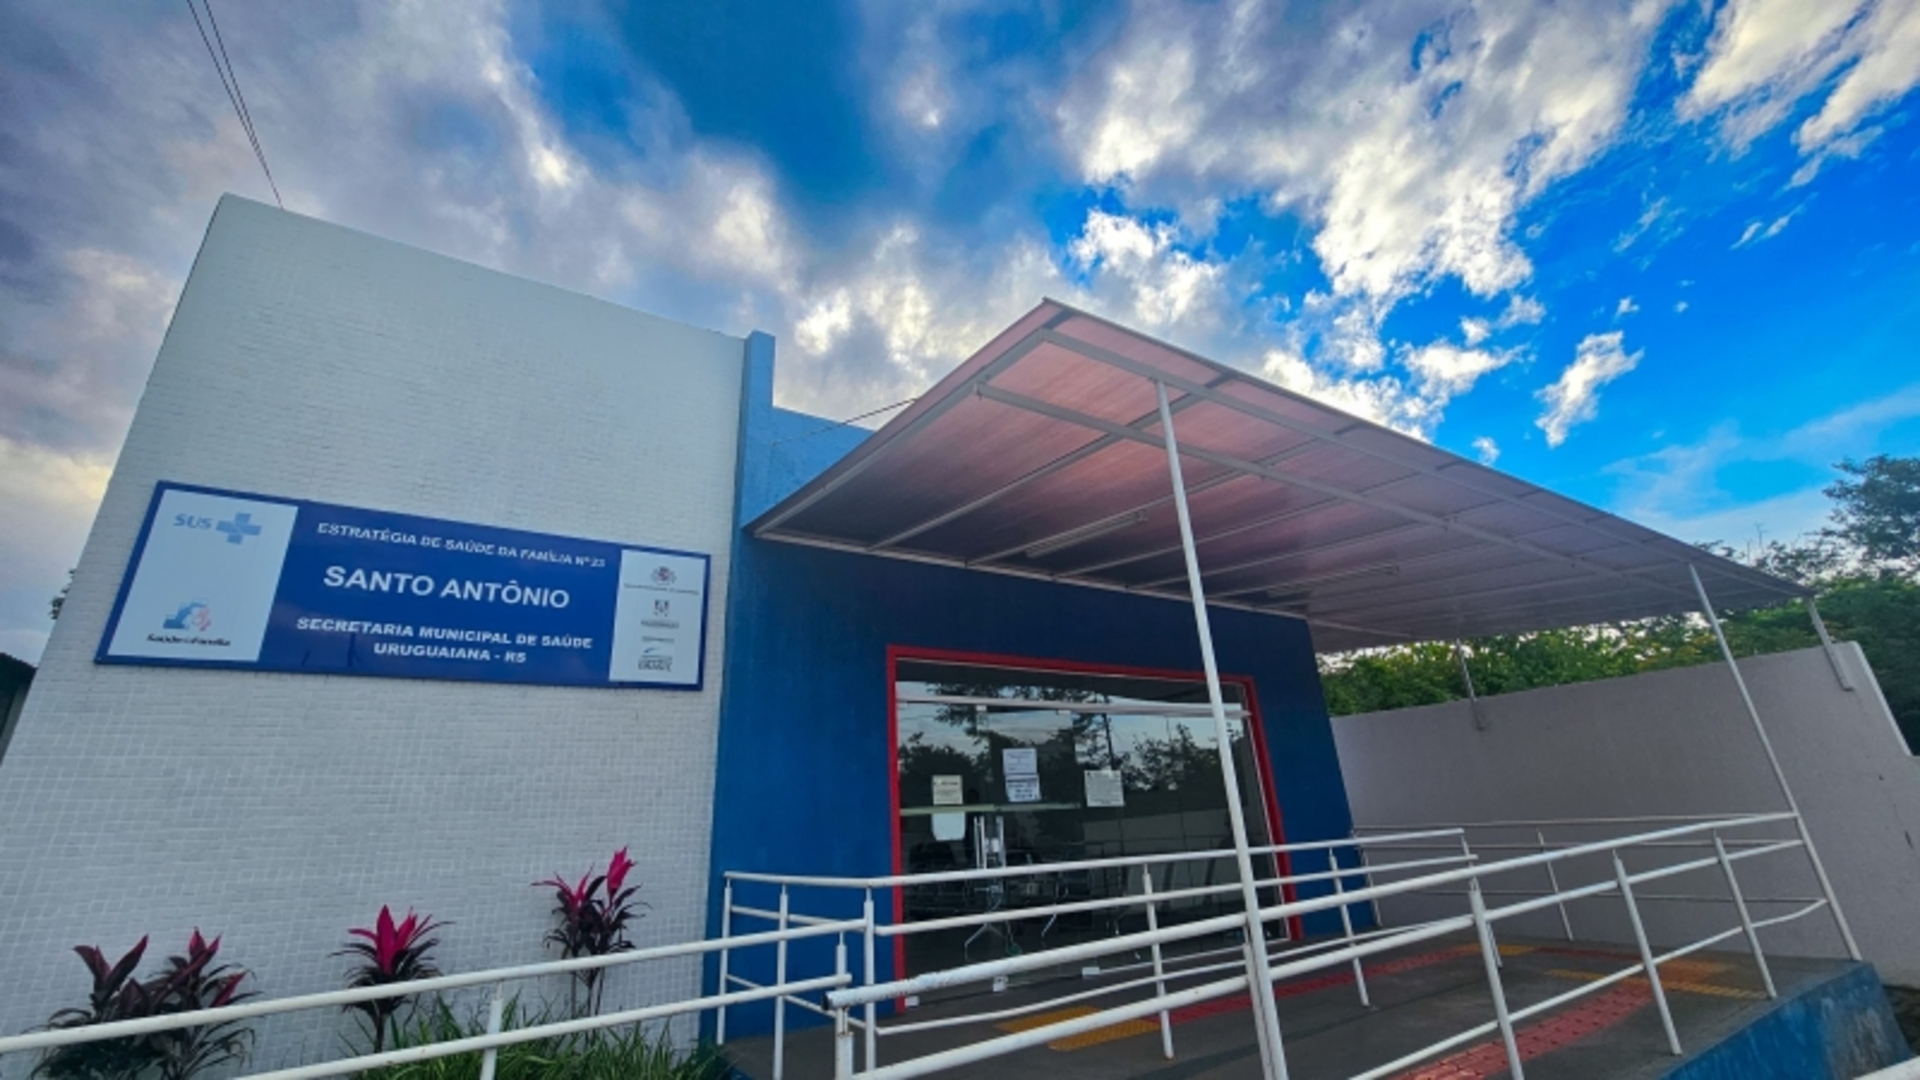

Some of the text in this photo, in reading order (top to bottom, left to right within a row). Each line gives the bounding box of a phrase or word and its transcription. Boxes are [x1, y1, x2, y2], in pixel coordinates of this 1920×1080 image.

[173, 513, 213, 529] SUS
[317, 522, 418, 545] ESTRATÉGIA
[420, 535, 442, 548] DE
[445, 540, 495, 555] SAÚDE
[498, 546, 517, 557] DA
[520, 548, 572, 565] FAMÍLIA
[324, 565, 570, 608] SANTO ANTÔNIO
[296, 617, 593, 649] SECRETARIA MUNICIPAL DE SAÚDE
[373, 642, 491, 661] URUGUAIANA
[504, 651, 527, 663] RS
